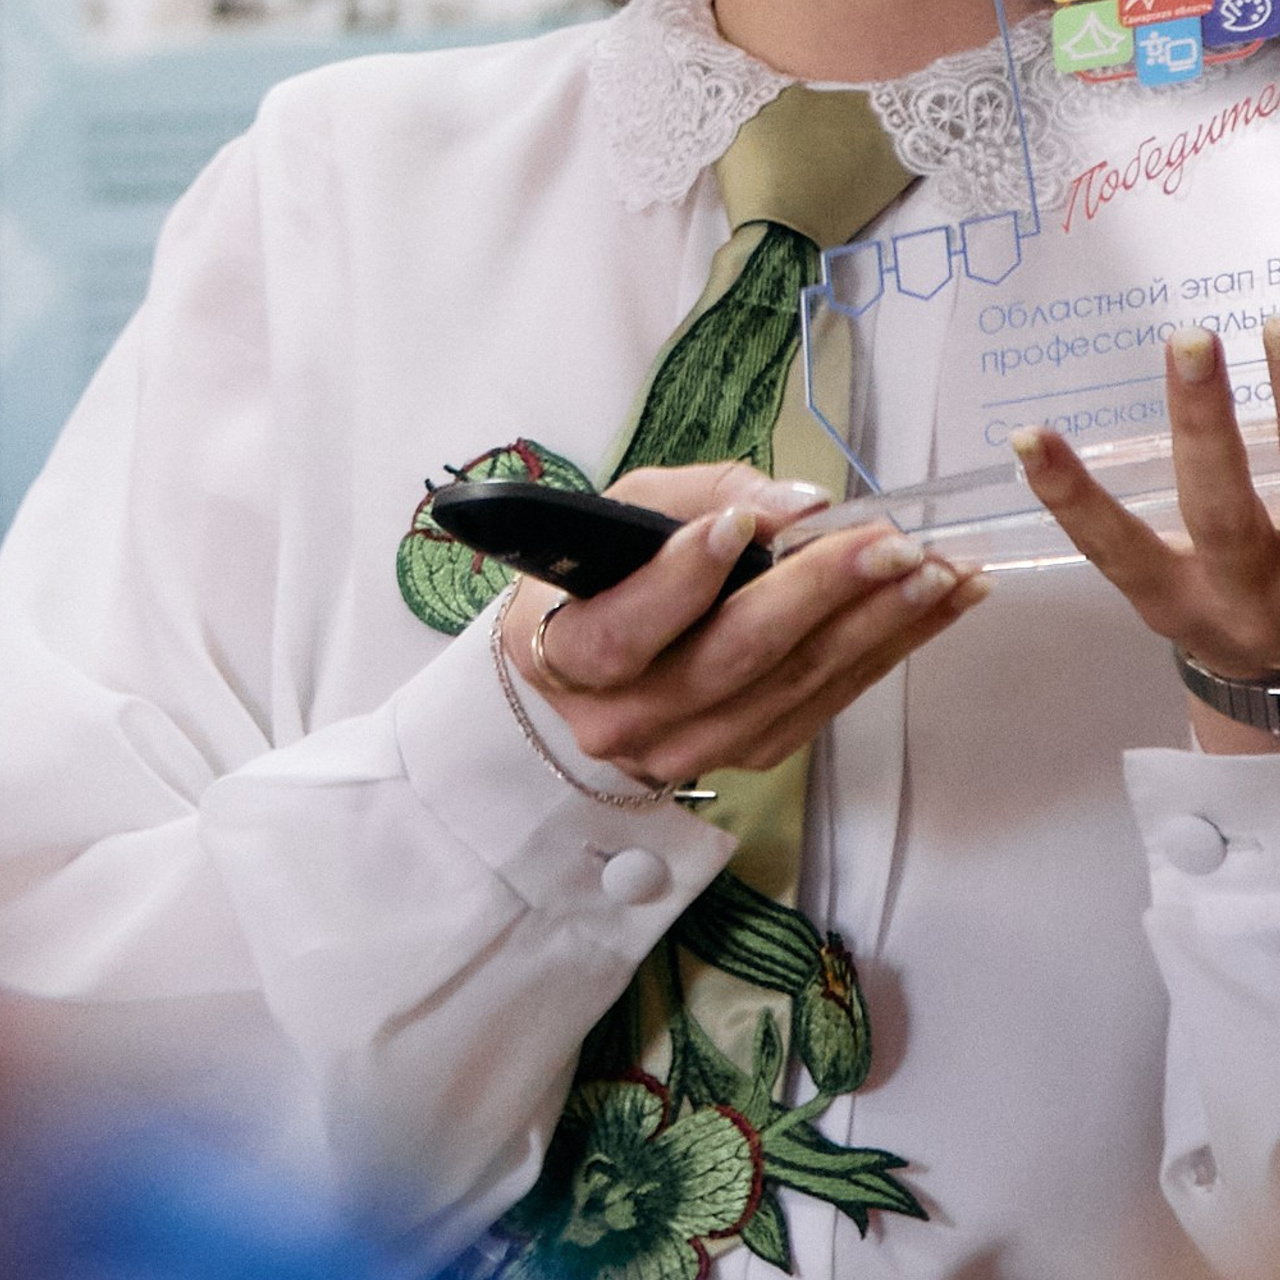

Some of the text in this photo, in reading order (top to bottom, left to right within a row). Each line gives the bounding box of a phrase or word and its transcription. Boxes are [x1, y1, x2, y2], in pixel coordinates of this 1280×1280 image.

[979, 277, 1169, 335] Областной
[1180, 270, 1254, 300] этап
[984, 399, 1164, 447] Сарская
